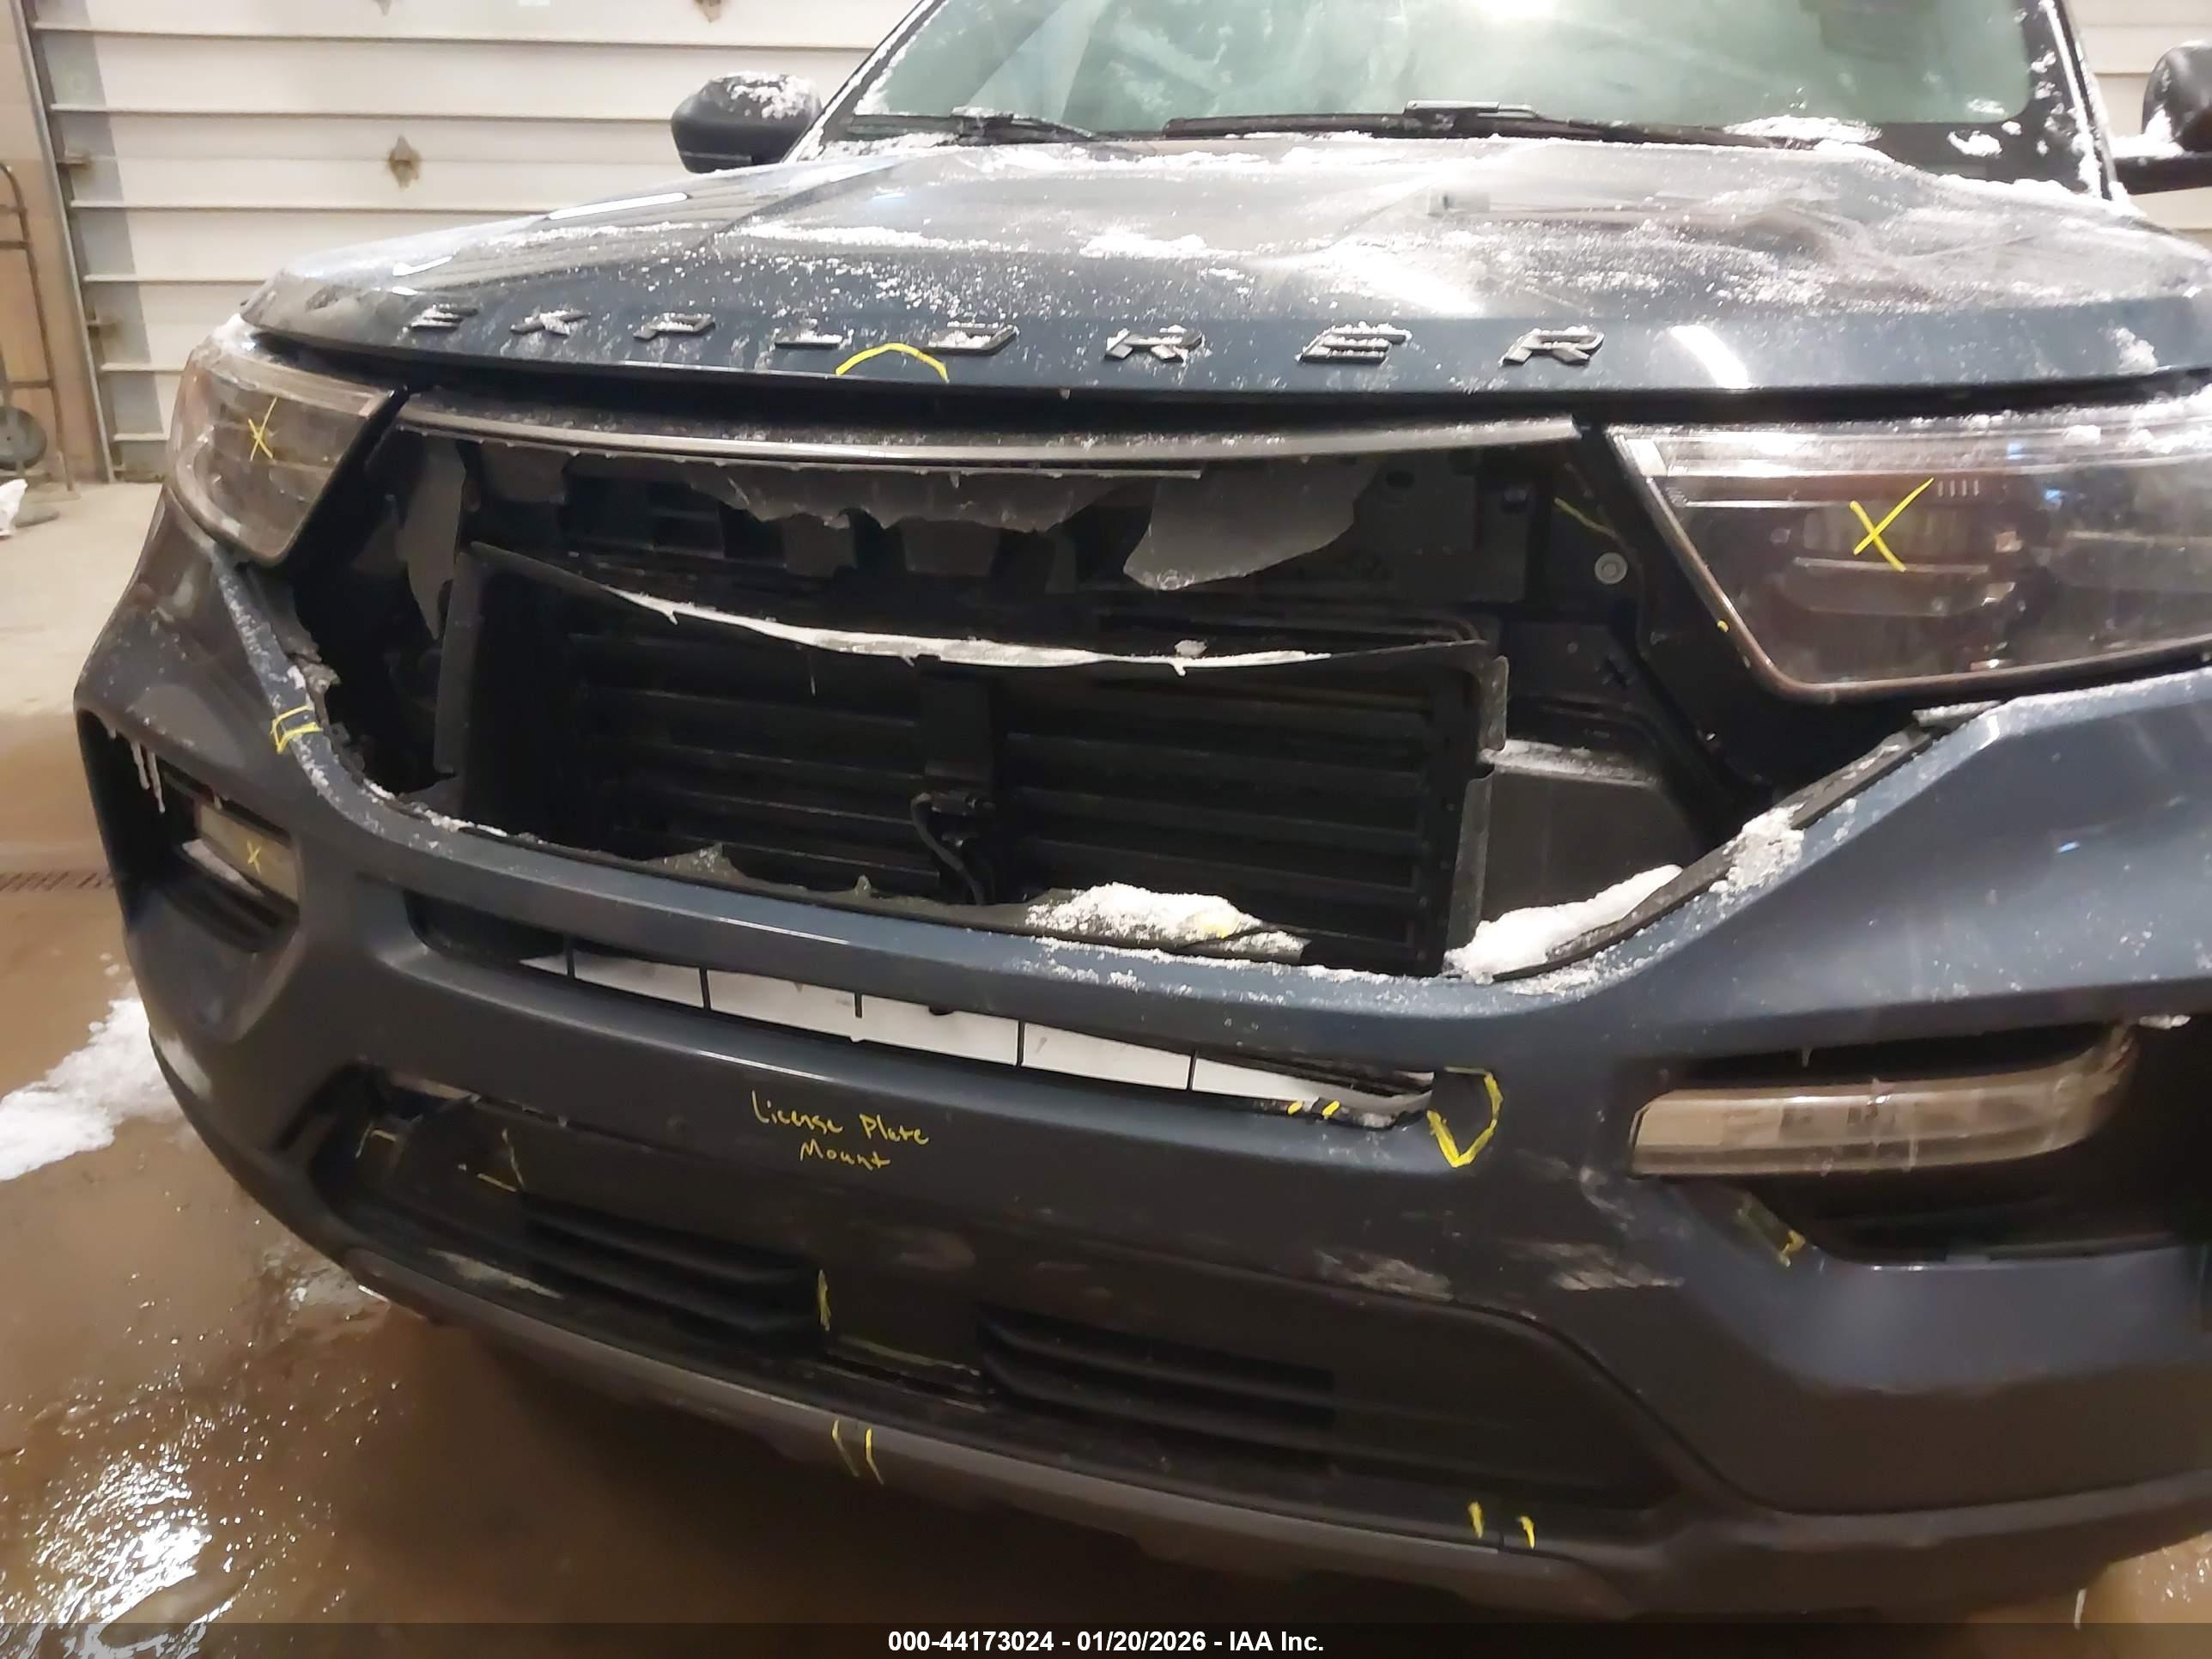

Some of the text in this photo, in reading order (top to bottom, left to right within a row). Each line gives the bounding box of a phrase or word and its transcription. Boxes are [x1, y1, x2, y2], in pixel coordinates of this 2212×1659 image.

[410, 304, 1605, 367] EXPLORER
[751, 1090, 843, 1134] License
[799, 1138, 891, 1170] Mount
